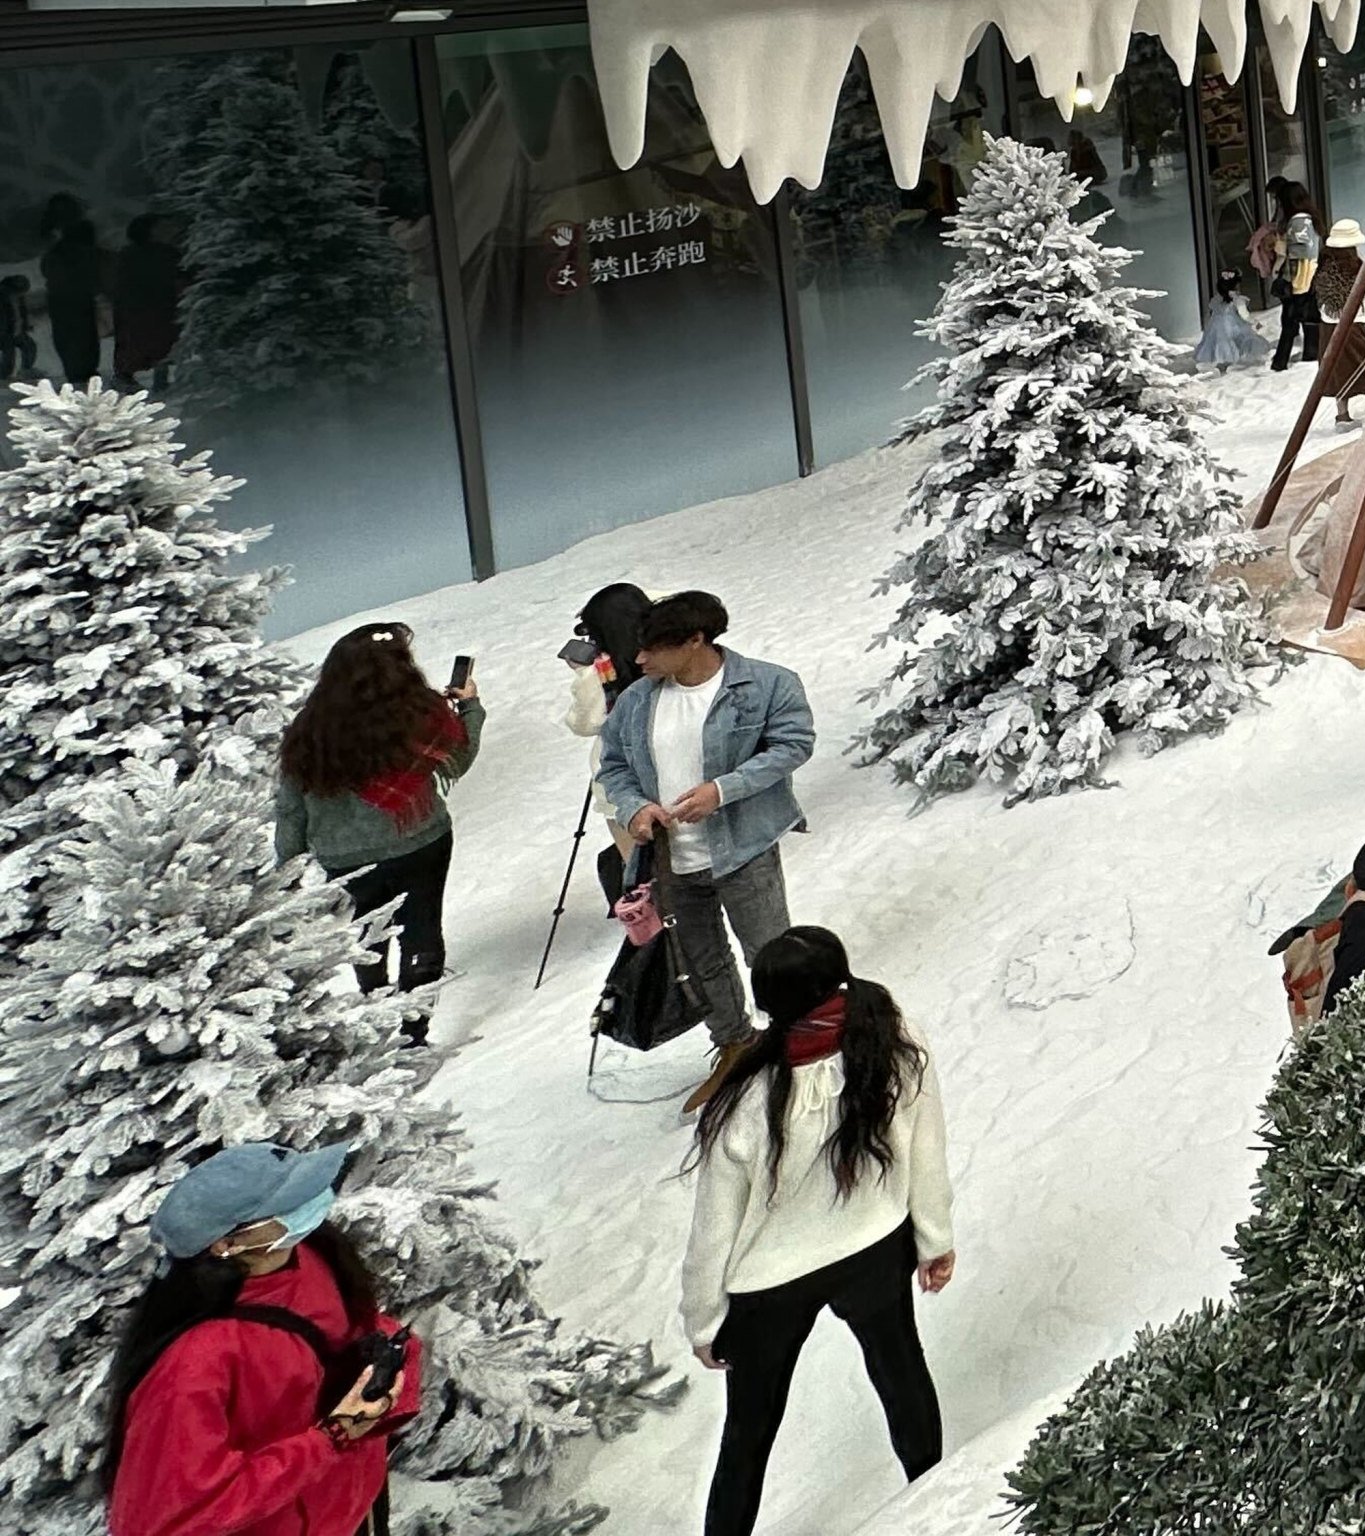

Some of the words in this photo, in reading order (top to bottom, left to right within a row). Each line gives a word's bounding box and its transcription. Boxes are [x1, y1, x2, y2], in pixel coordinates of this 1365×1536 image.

[585, 201, 702, 245] 禁止扬沙
[589, 239, 707, 285] 禁止奔跑
